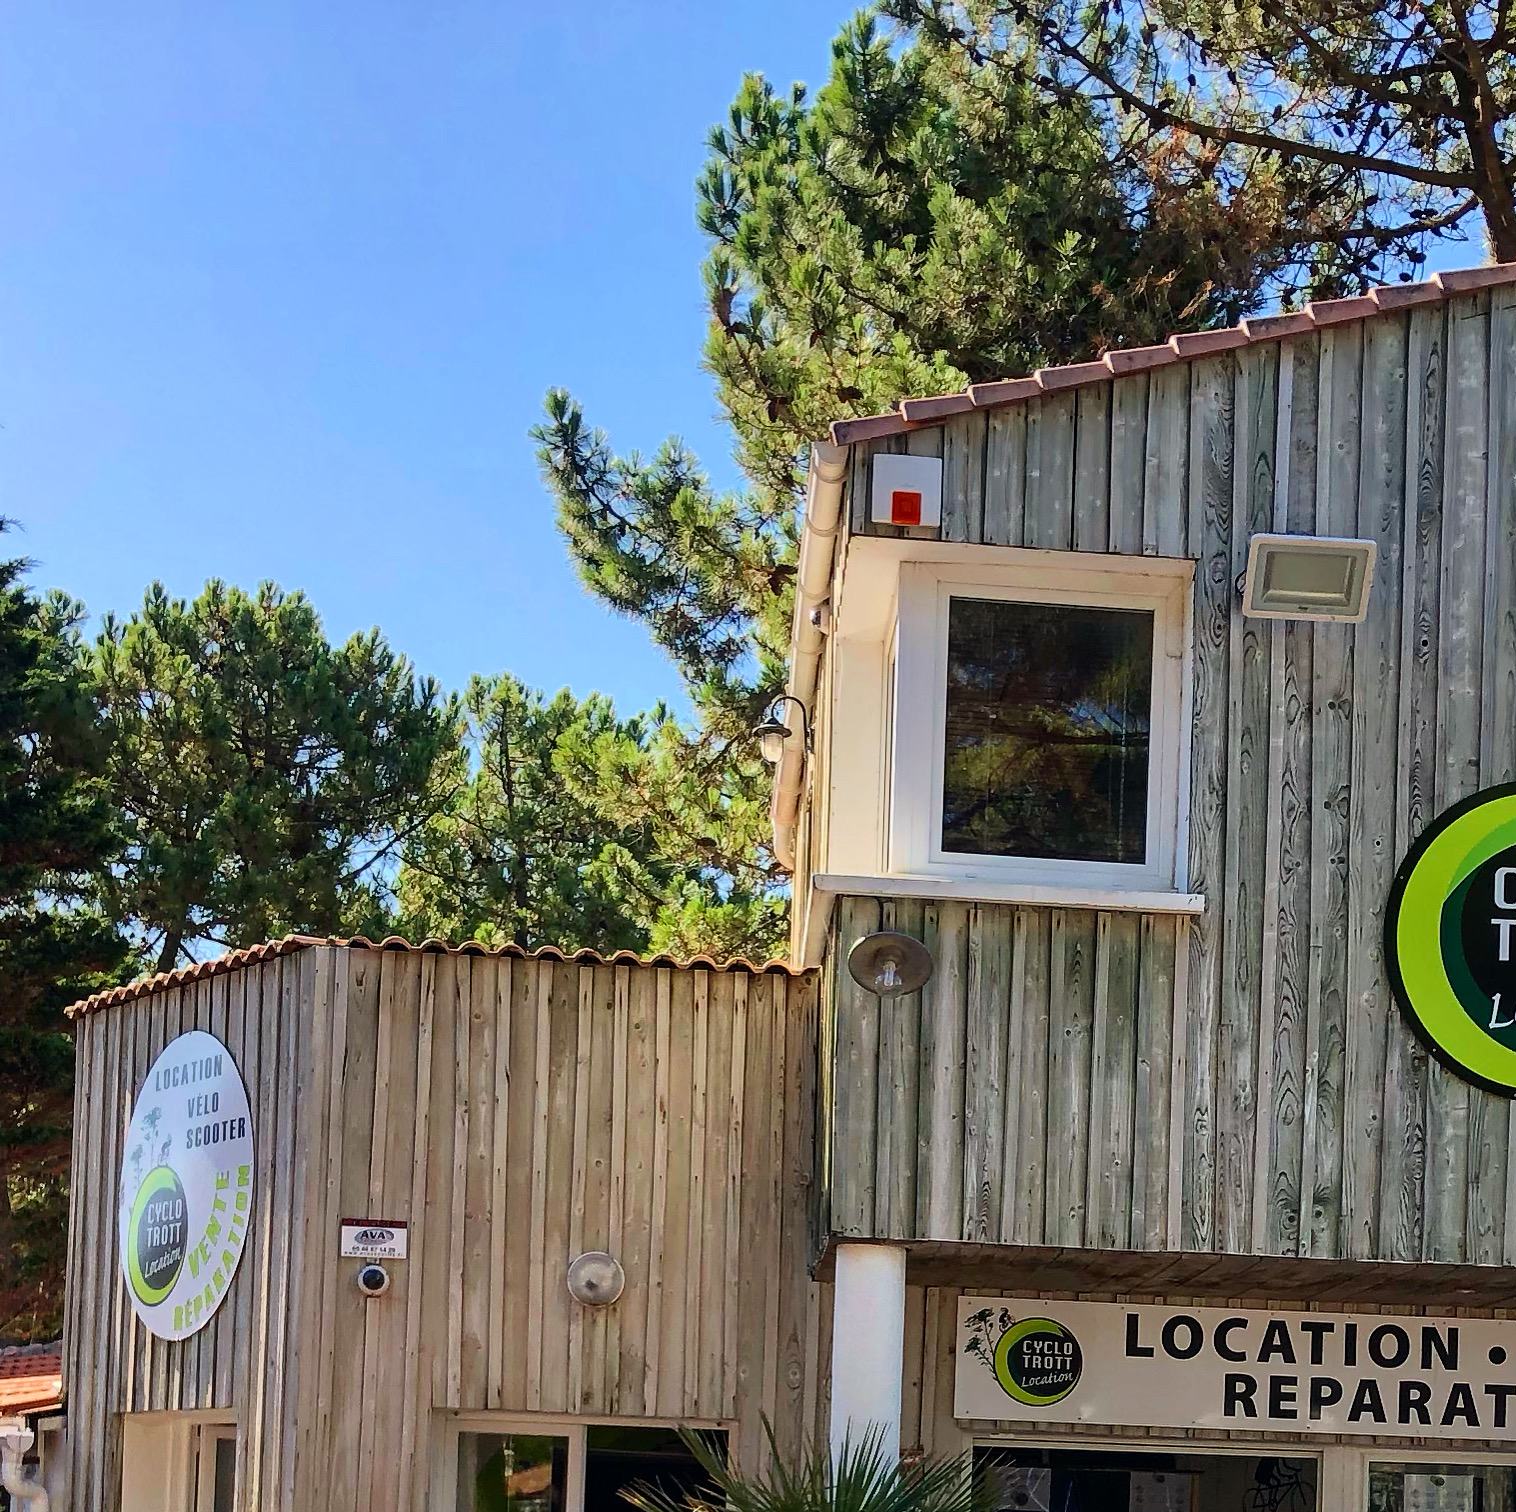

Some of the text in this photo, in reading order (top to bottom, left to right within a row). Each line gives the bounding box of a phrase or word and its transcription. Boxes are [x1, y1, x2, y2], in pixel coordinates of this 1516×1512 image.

[154, 1053, 223, 1093] LOCATION
[186, 1116, 247, 1150] SCOOTER
[146, 1198, 183, 1225] CYCLO
[187, 1169, 230, 1280] VENTE
[146, 1222, 182, 1249] TROTT
[360, 1230, 386, 1240] AVA
[144, 1246, 183, 1280] Location
[1022, 1340, 1073, 1355] CYCLO
[1125, 1312, 1460, 1371] LOCATION
[1022, 1355, 1073, 1370] TROTT
[1021, 1371, 1073, 1388] Location
